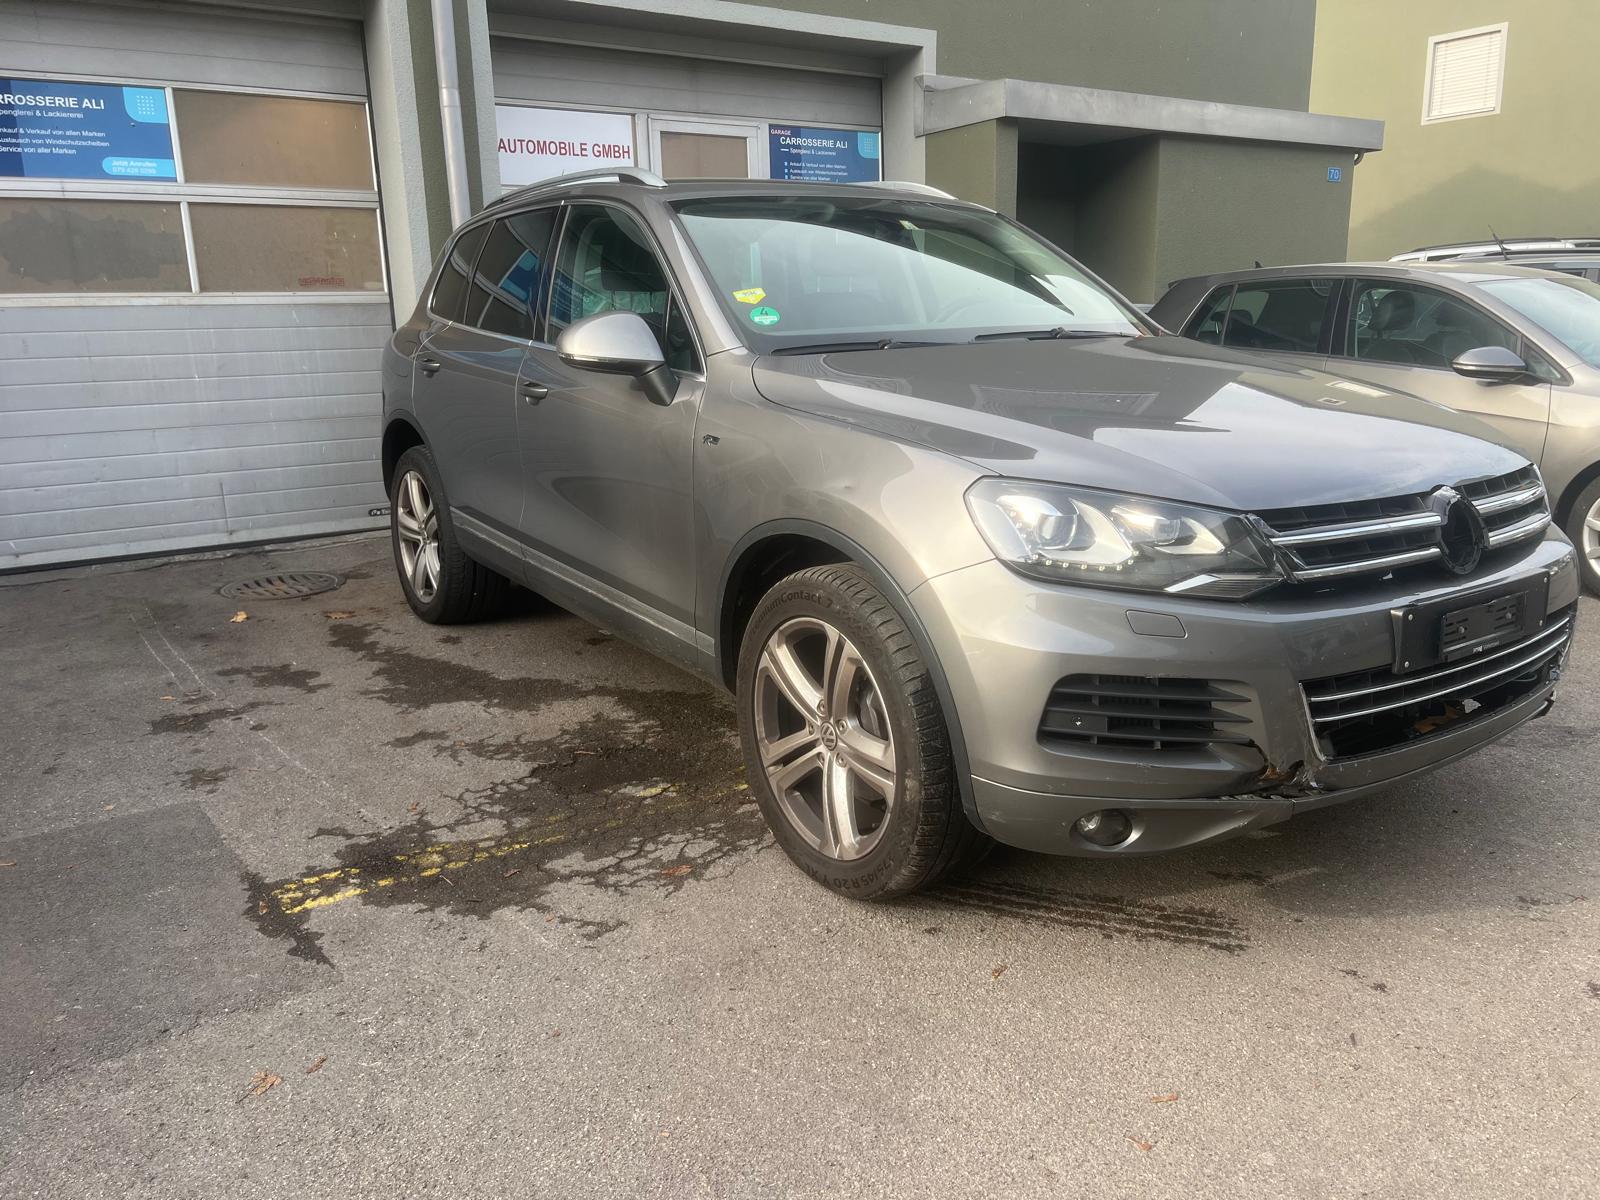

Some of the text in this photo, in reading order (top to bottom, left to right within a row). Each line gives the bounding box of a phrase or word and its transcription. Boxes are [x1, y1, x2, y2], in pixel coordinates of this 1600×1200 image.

[82, 98, 105, 110] ALI
[780, 136, 848, 149] CARROSSERIE ALI
[497, 138, 631, 160] AUTOMOBILE GMBH
[1330, 169, 1339, 180] 70
